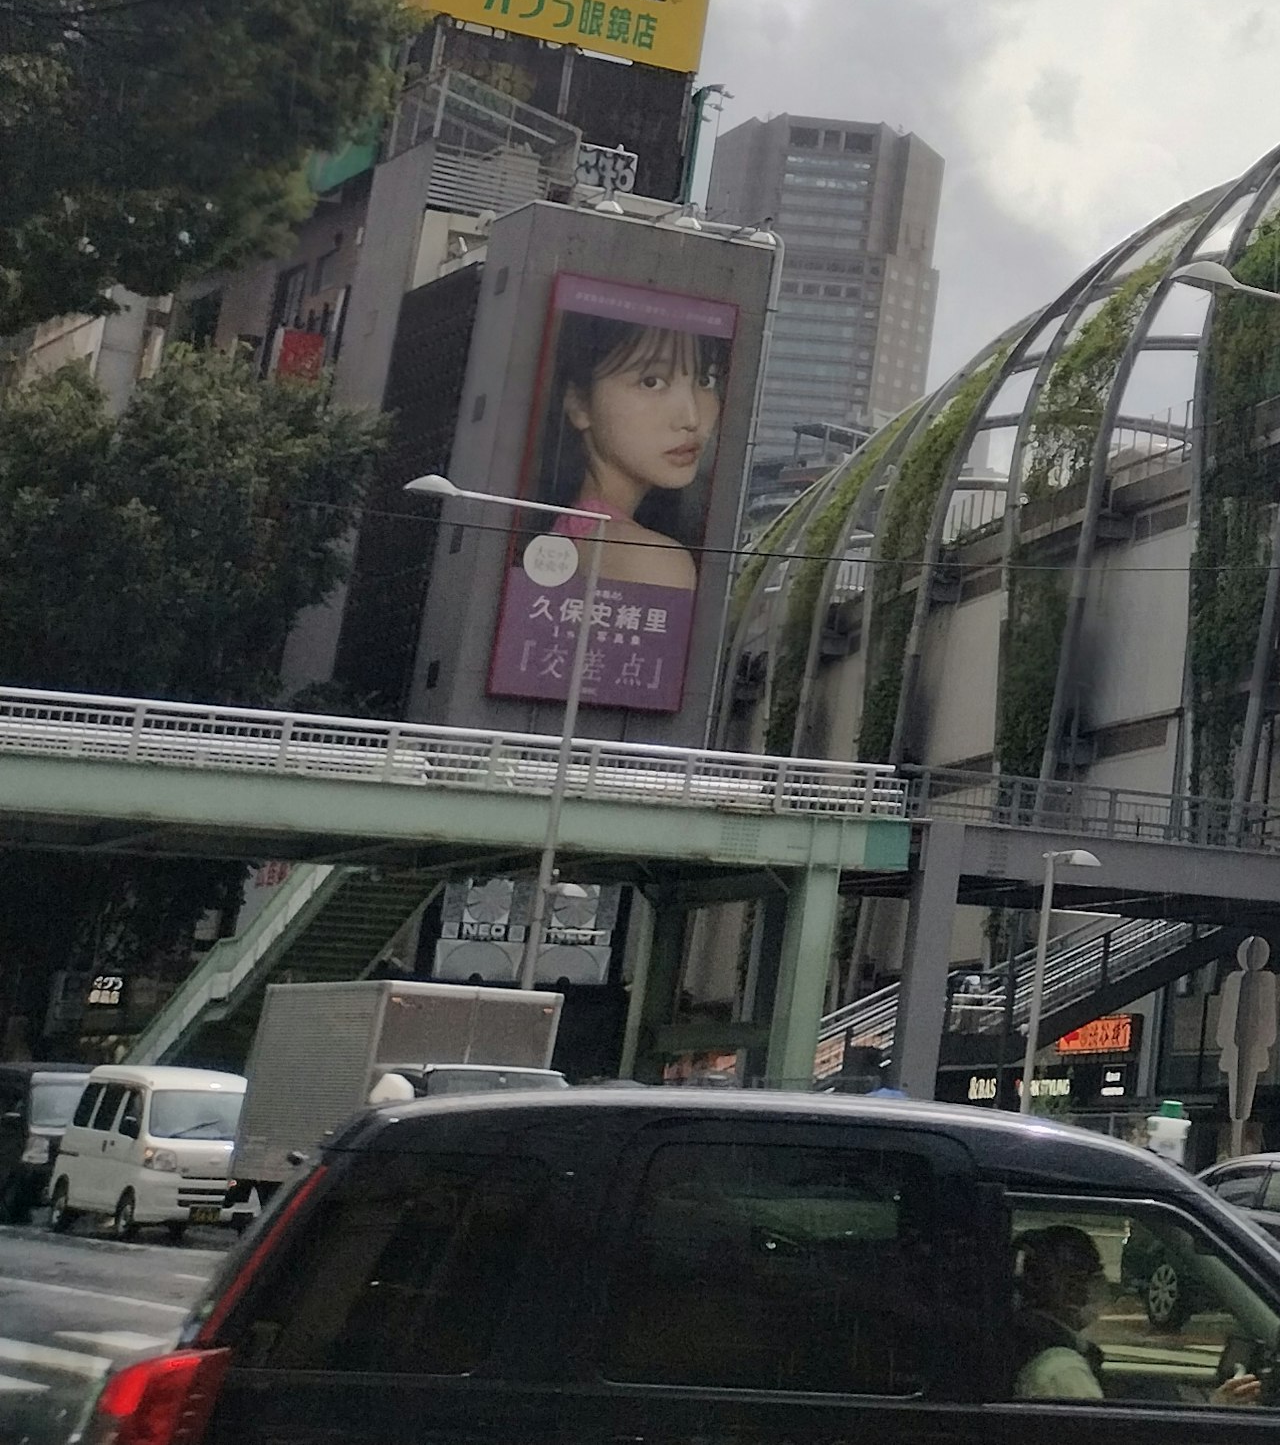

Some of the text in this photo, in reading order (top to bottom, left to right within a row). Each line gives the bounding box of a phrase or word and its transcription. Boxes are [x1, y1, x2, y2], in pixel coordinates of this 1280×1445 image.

[529, 595, 668, 633] 久保史緒里
[520, 639, 664, 689] 『交差点』
[463, 922, 506, 937] NEO
